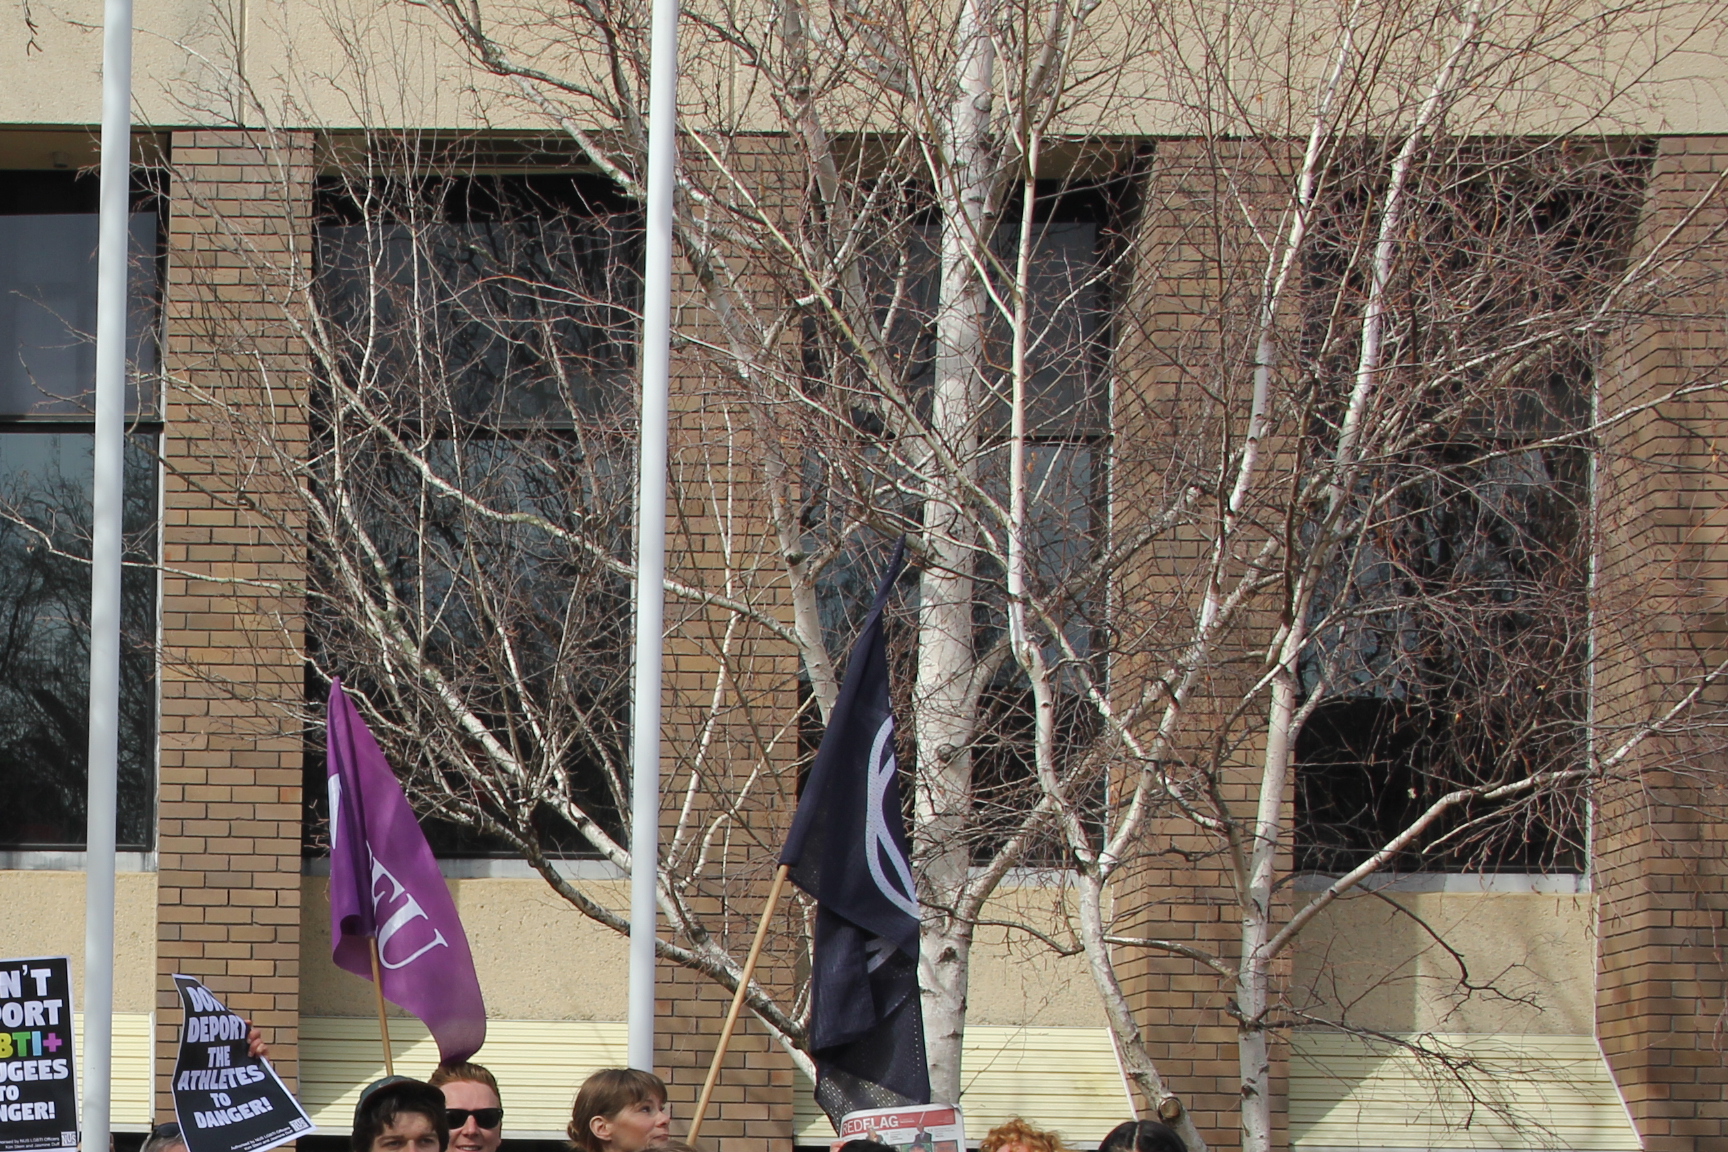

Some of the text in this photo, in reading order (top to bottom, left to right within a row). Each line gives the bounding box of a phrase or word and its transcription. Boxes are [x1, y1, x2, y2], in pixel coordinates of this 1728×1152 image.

[187, 1015, 246, 1043] DEPORT
[207, 1046, 231, 1067] THE
[177, 1065, 265, 1090] ATHLETES
[194, 1096, 273, 1129] DANGER!
[210, 1092, 232, 1108] TO
